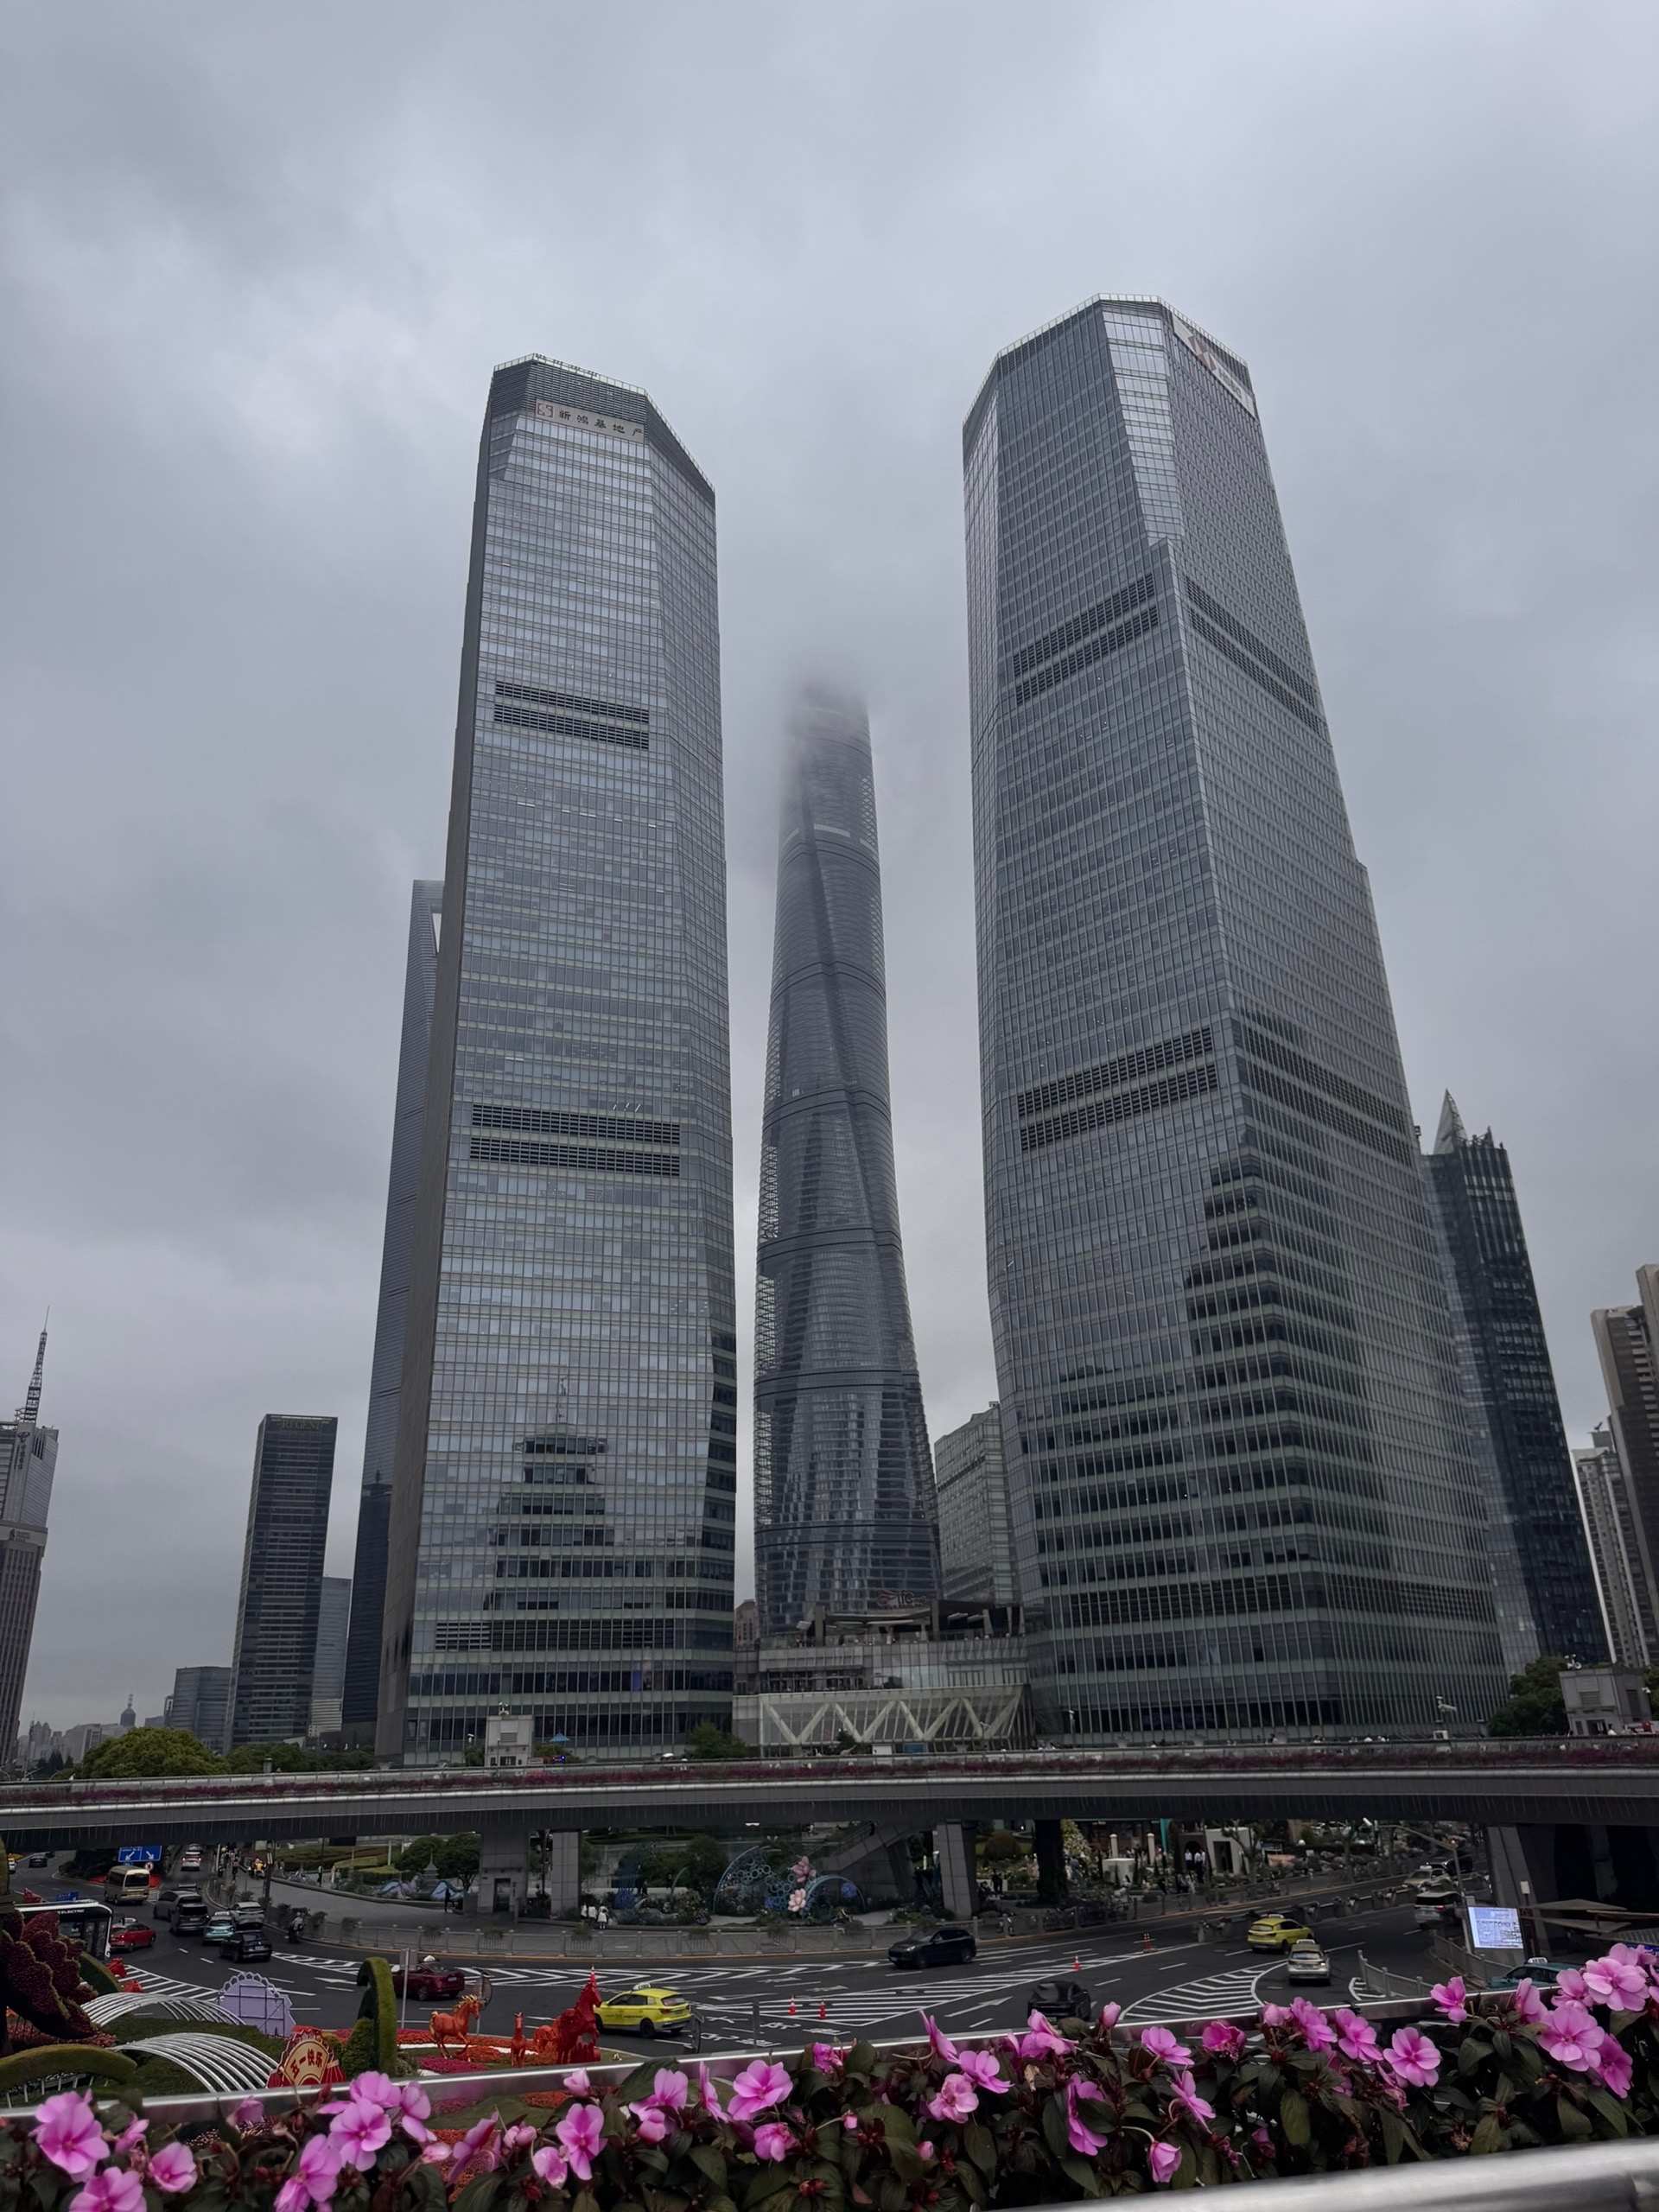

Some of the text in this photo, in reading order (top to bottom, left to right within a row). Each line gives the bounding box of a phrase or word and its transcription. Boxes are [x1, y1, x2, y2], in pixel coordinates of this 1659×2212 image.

[558, 410, 643, 436] 新鸿基地产
[282, 1419, 320, 1430] REGENT
[289, 2048, 323, 2080] 五一快乐
